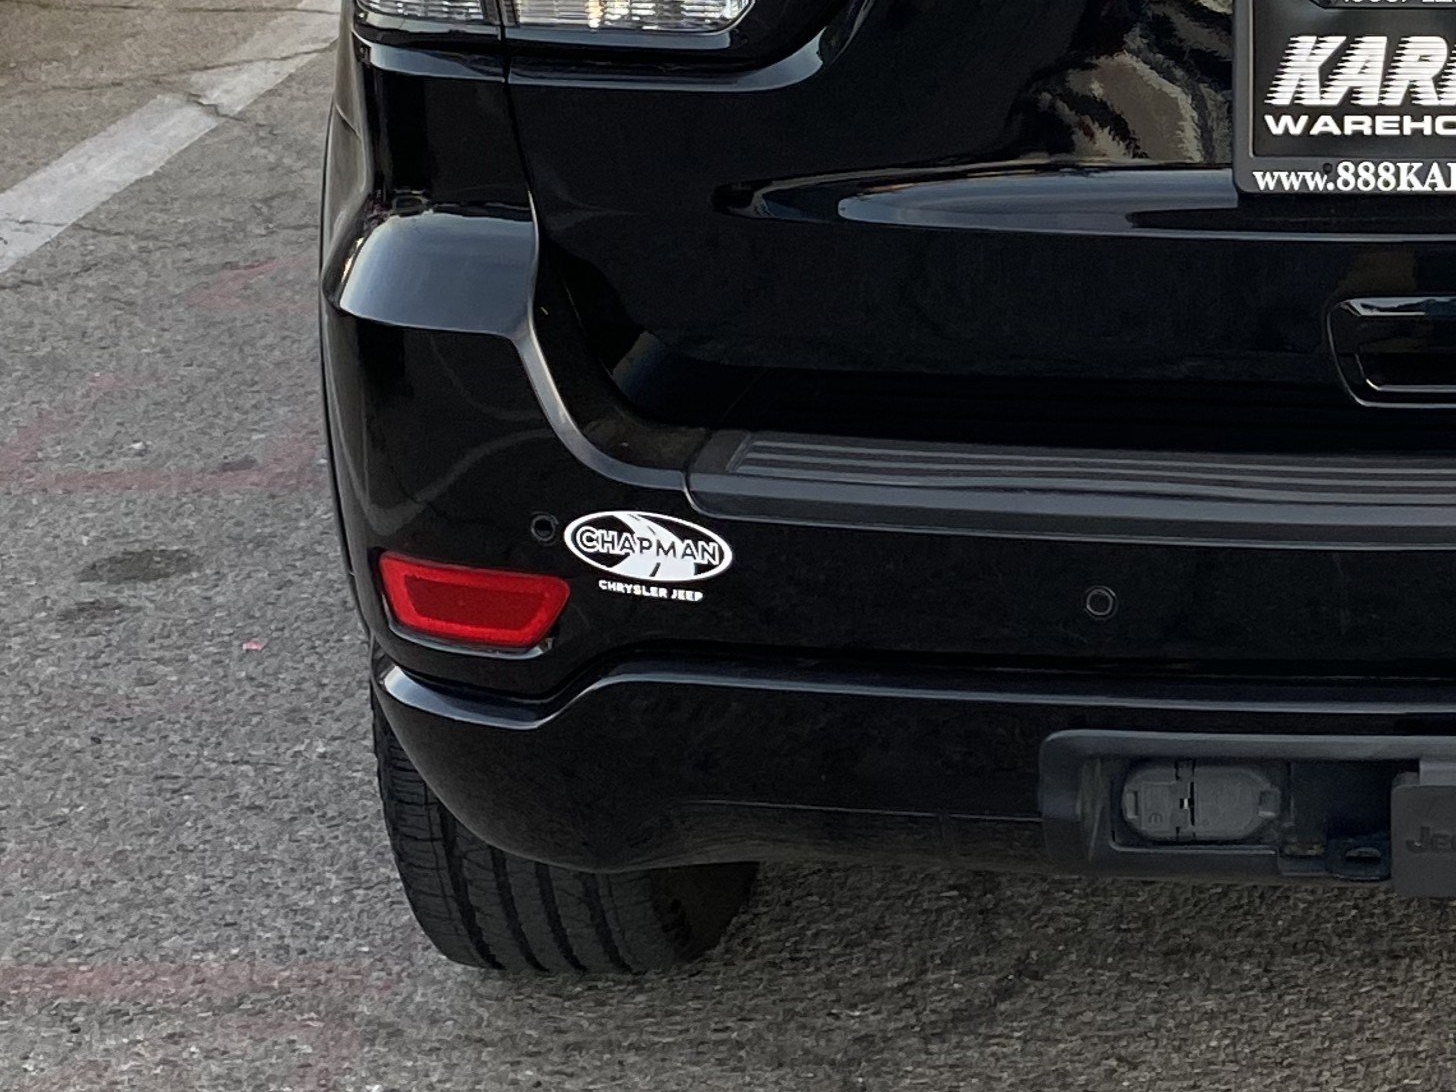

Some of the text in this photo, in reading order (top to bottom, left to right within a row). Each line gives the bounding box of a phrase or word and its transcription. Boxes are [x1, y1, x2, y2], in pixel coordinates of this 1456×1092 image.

[576, 525, 721, 566] CHAPMAN
[598, 579, 704, 602] CHRYSLER JEEP
